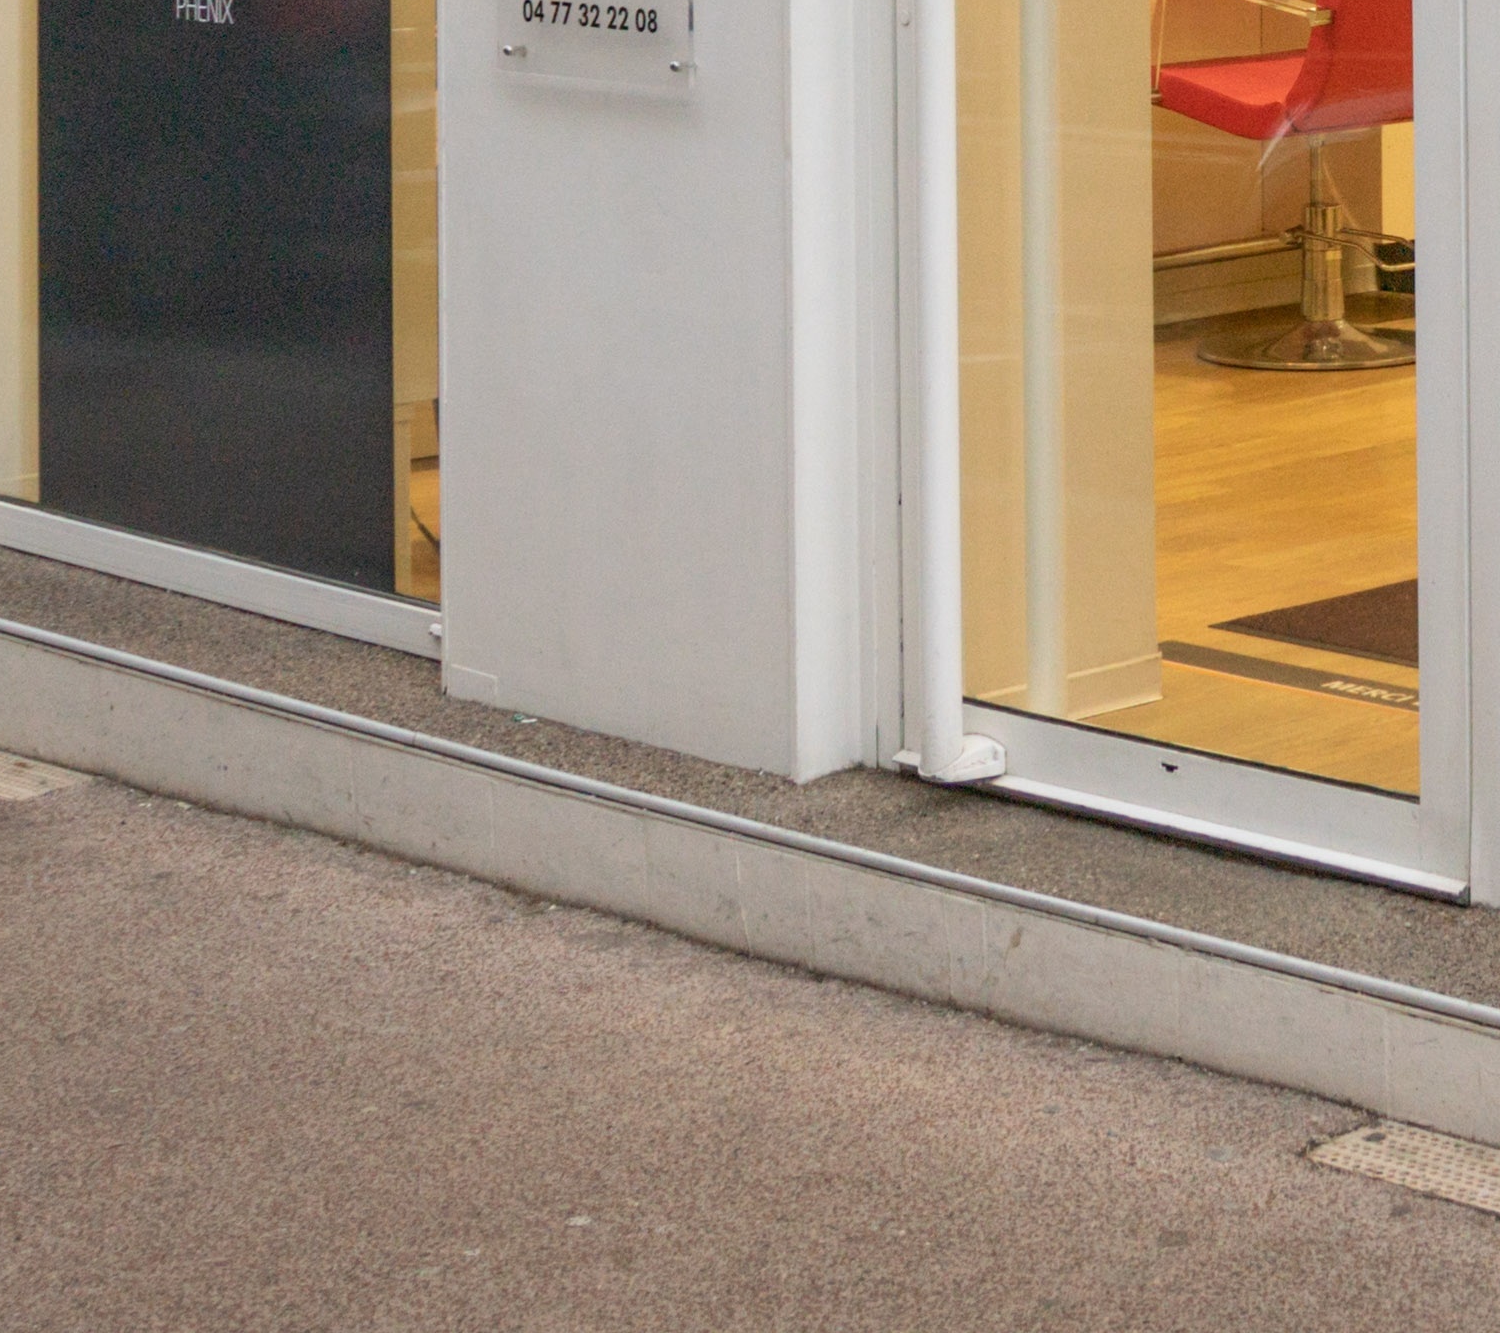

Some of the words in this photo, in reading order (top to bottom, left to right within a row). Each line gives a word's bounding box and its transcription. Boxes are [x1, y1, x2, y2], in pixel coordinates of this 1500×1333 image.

[550, 1, 573, 26] 77
[578, 4, 601, 28] 32
[606, 6, 630, 31] 22
[635, 8, 659, 33] 08
[1321, 680, 1415, 703] MERCI
